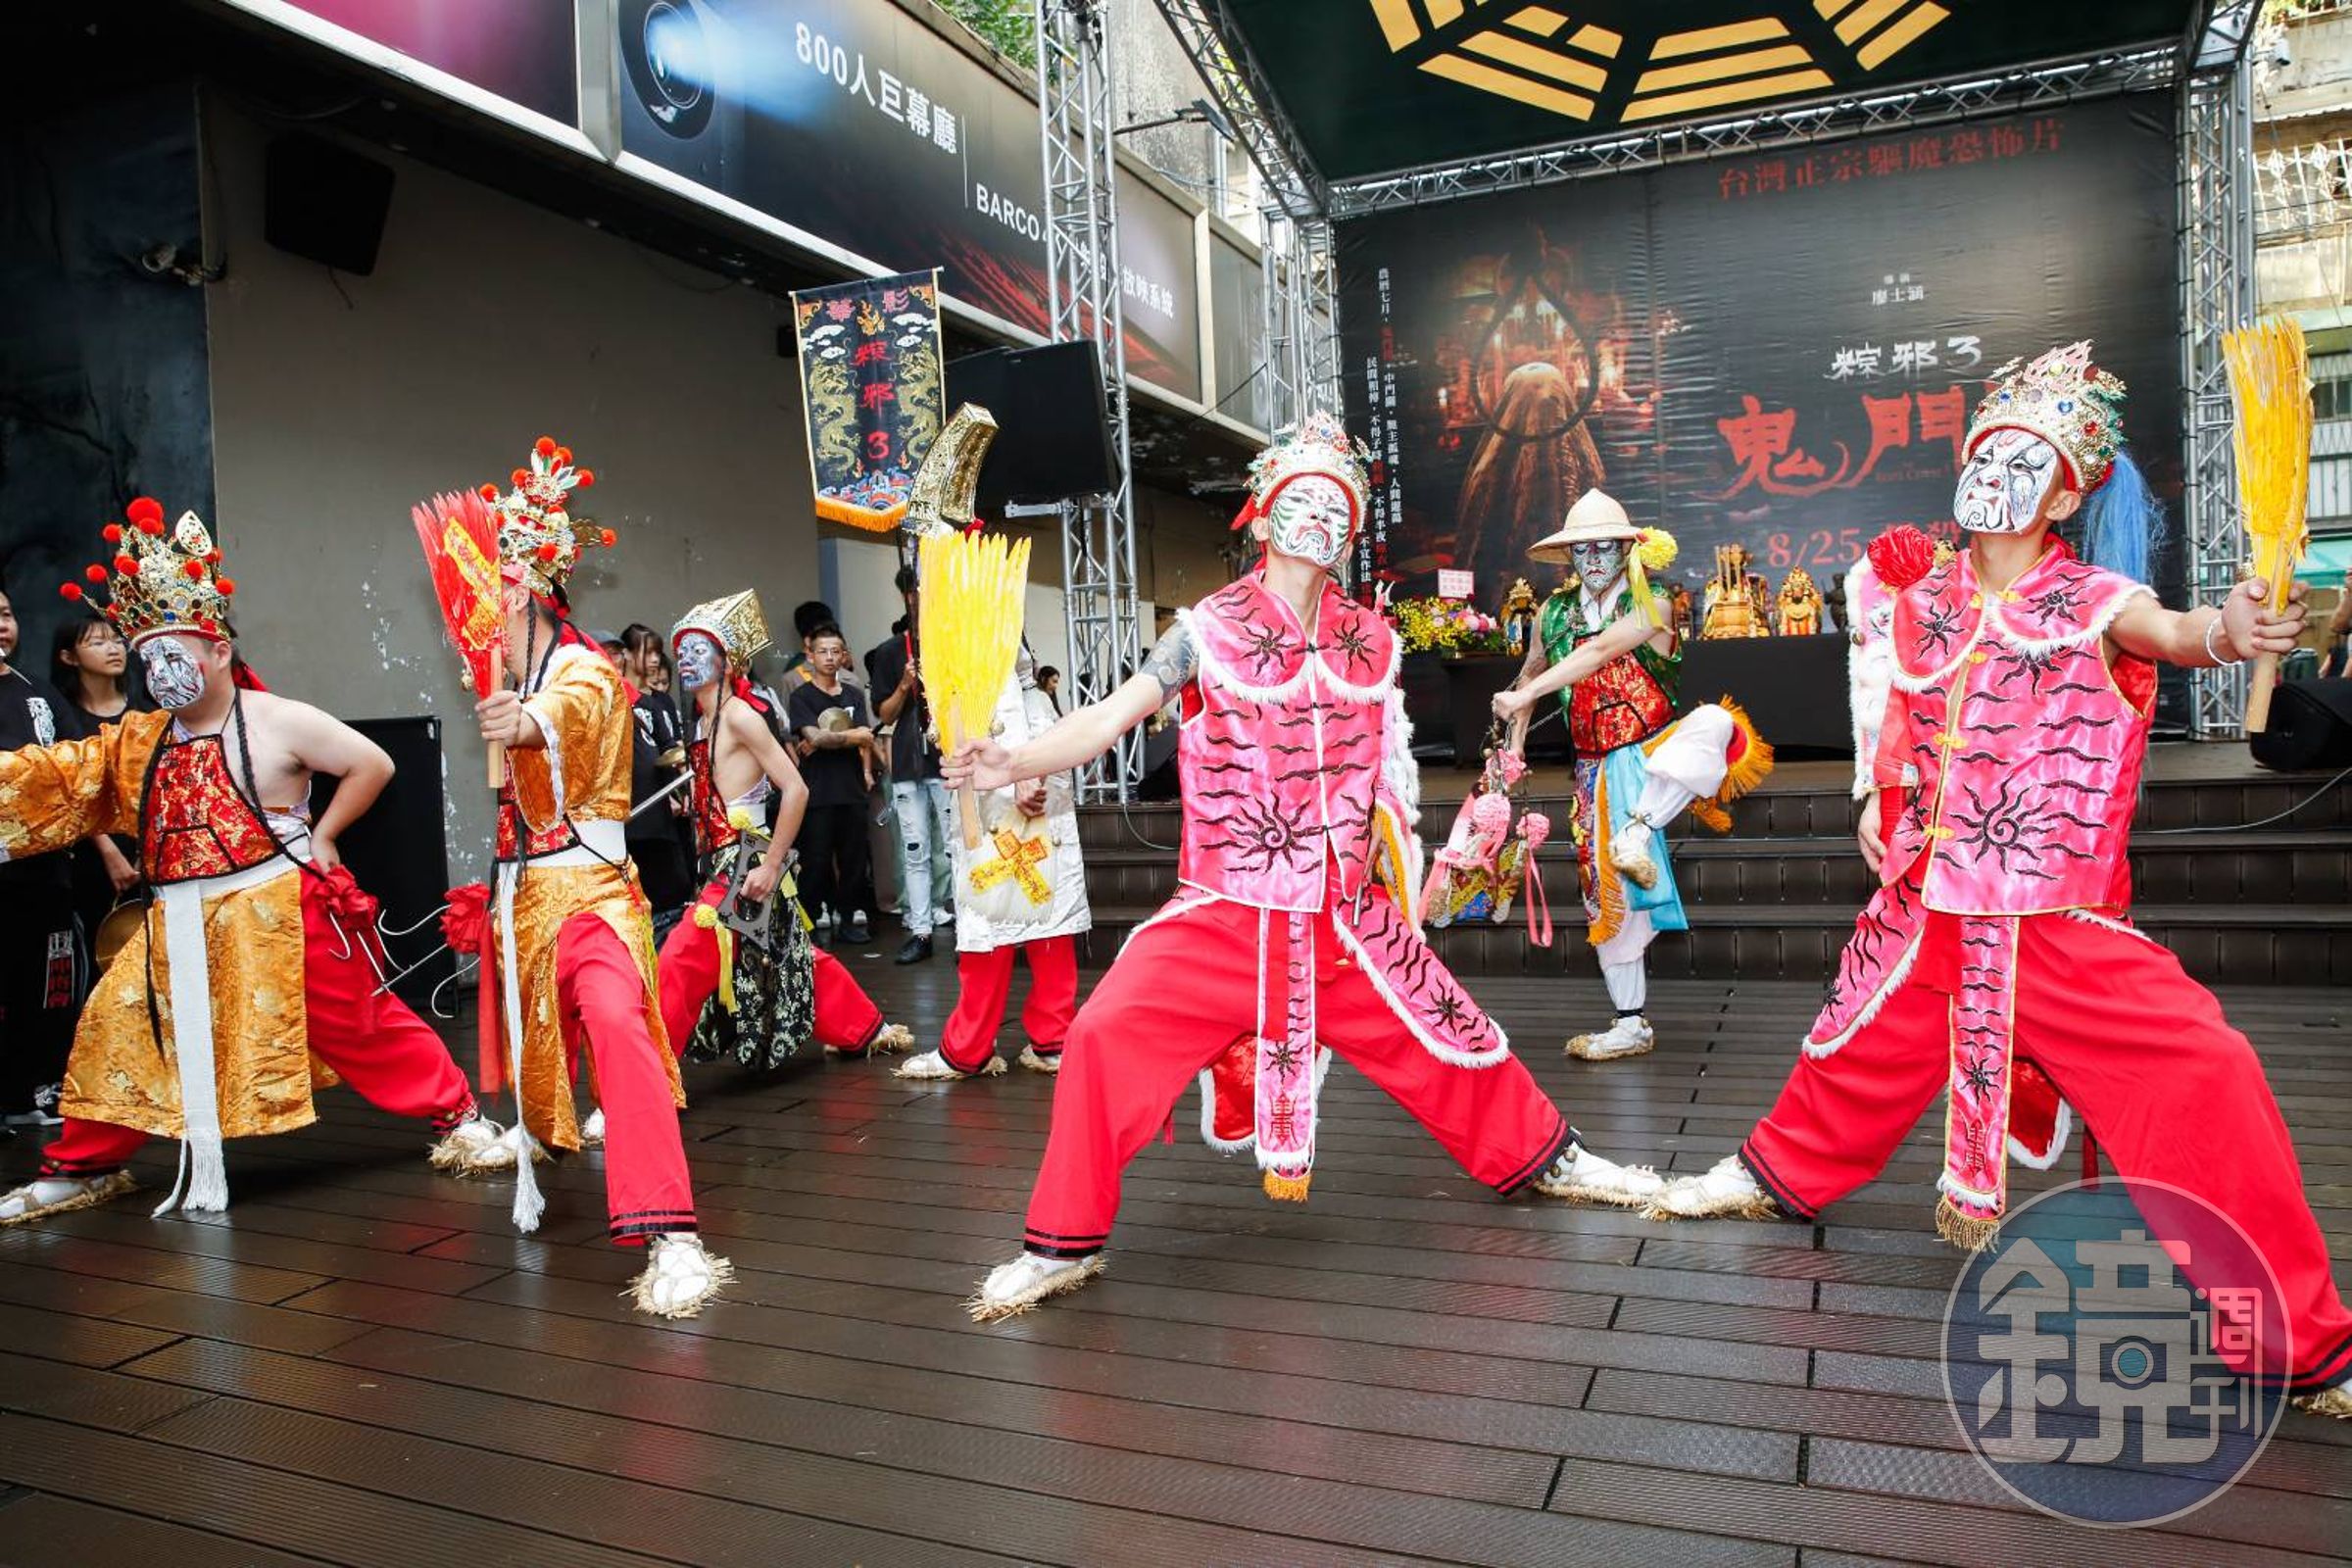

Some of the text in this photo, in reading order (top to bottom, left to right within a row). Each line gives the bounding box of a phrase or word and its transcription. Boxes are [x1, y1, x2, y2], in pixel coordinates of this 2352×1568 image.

[796, 22, 957, 155] 800人巨幕廳
[1719, 119, 2065, 200] 台灣正宗驅魔恐怖片
[976, 182, 1040, 242] BARCO
[1823, 335, 1983, 383] 粽邪3
[1690, 381, 2000, 501] 鬼門
[1768, 527, 1862, 568] 8/25
